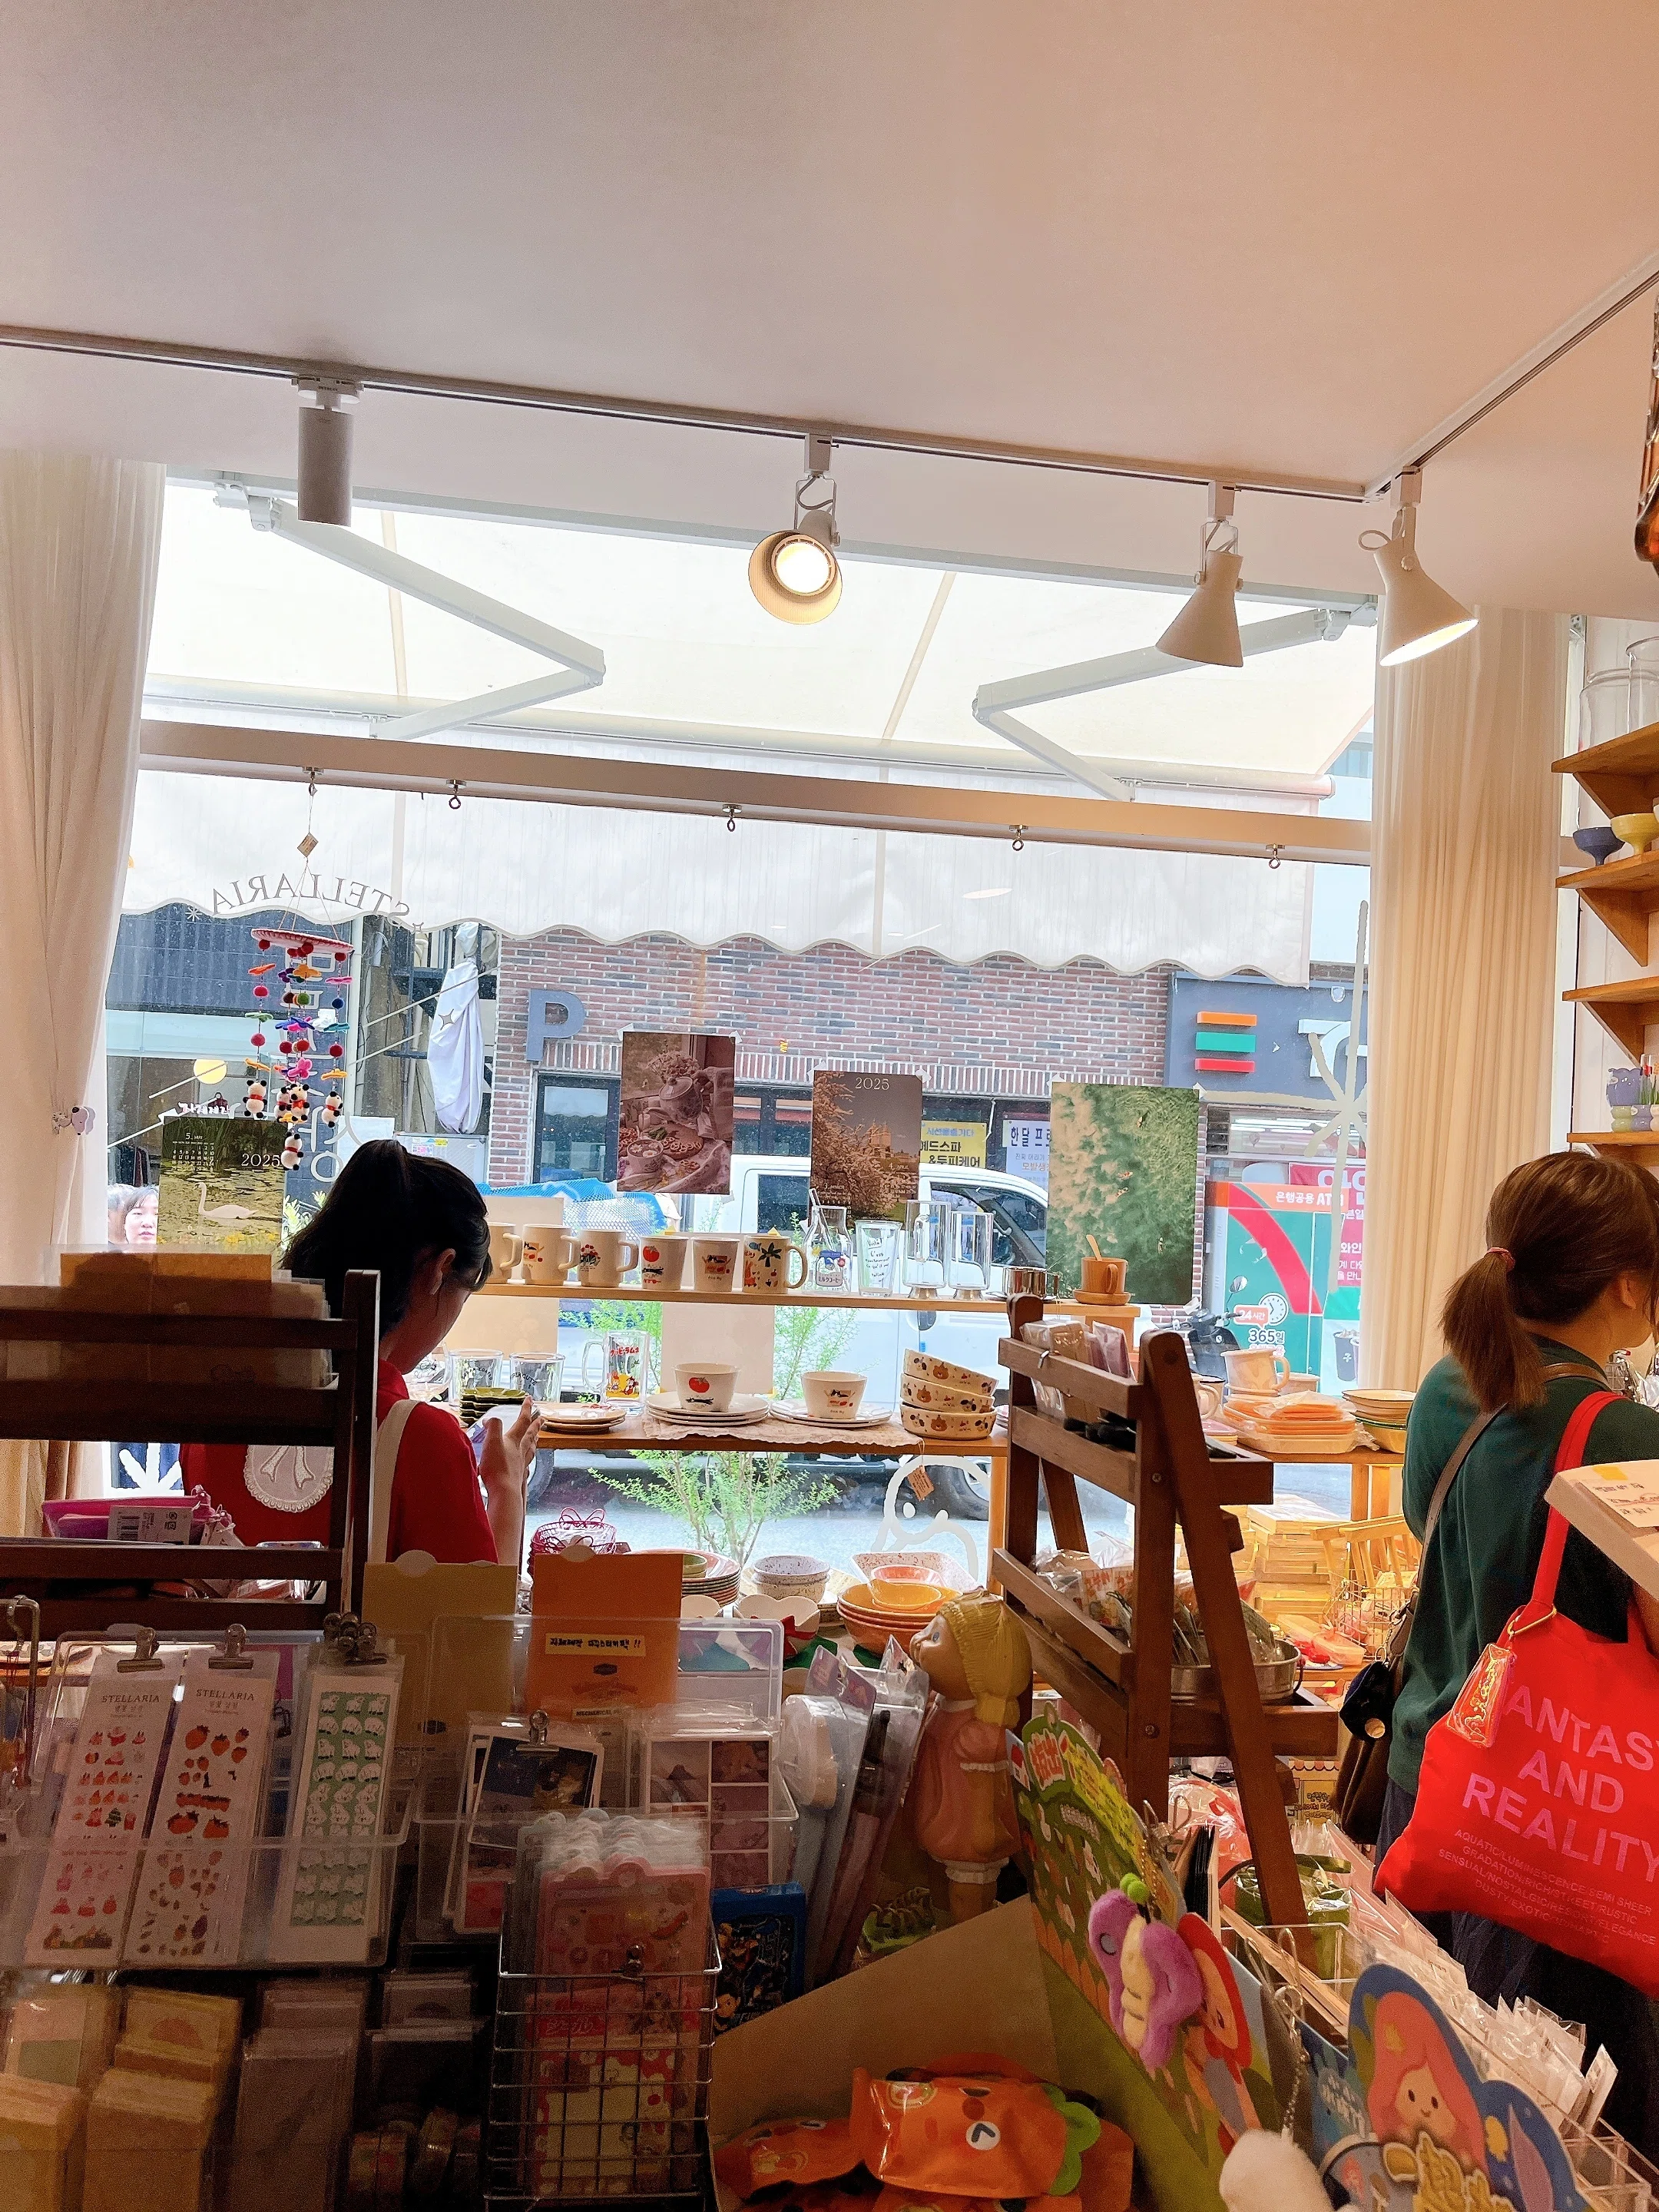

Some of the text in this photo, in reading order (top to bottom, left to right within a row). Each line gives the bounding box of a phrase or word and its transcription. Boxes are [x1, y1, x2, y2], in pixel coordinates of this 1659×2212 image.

[527, 988, 584, 1061] P
[855, 1078, 890, 1091] 2025
[241, 1154, 281, 1167] 2025
[1276, 1191, 1344, 1207] 은행공용 AT
[1249, 1329, 1285, 1343] 365일
[101, 1694, 161, 1703] STELLARIA
[196, 1689, 255, 1702] STELLARIA
[1504, 1685, 1659, 1771] ANTAS
[1518, 1750, 1624, 1813] AND
[1462, 1772, 1659, 1883] REALITY
[1617, 1897, 1654, 1916] SHEER
